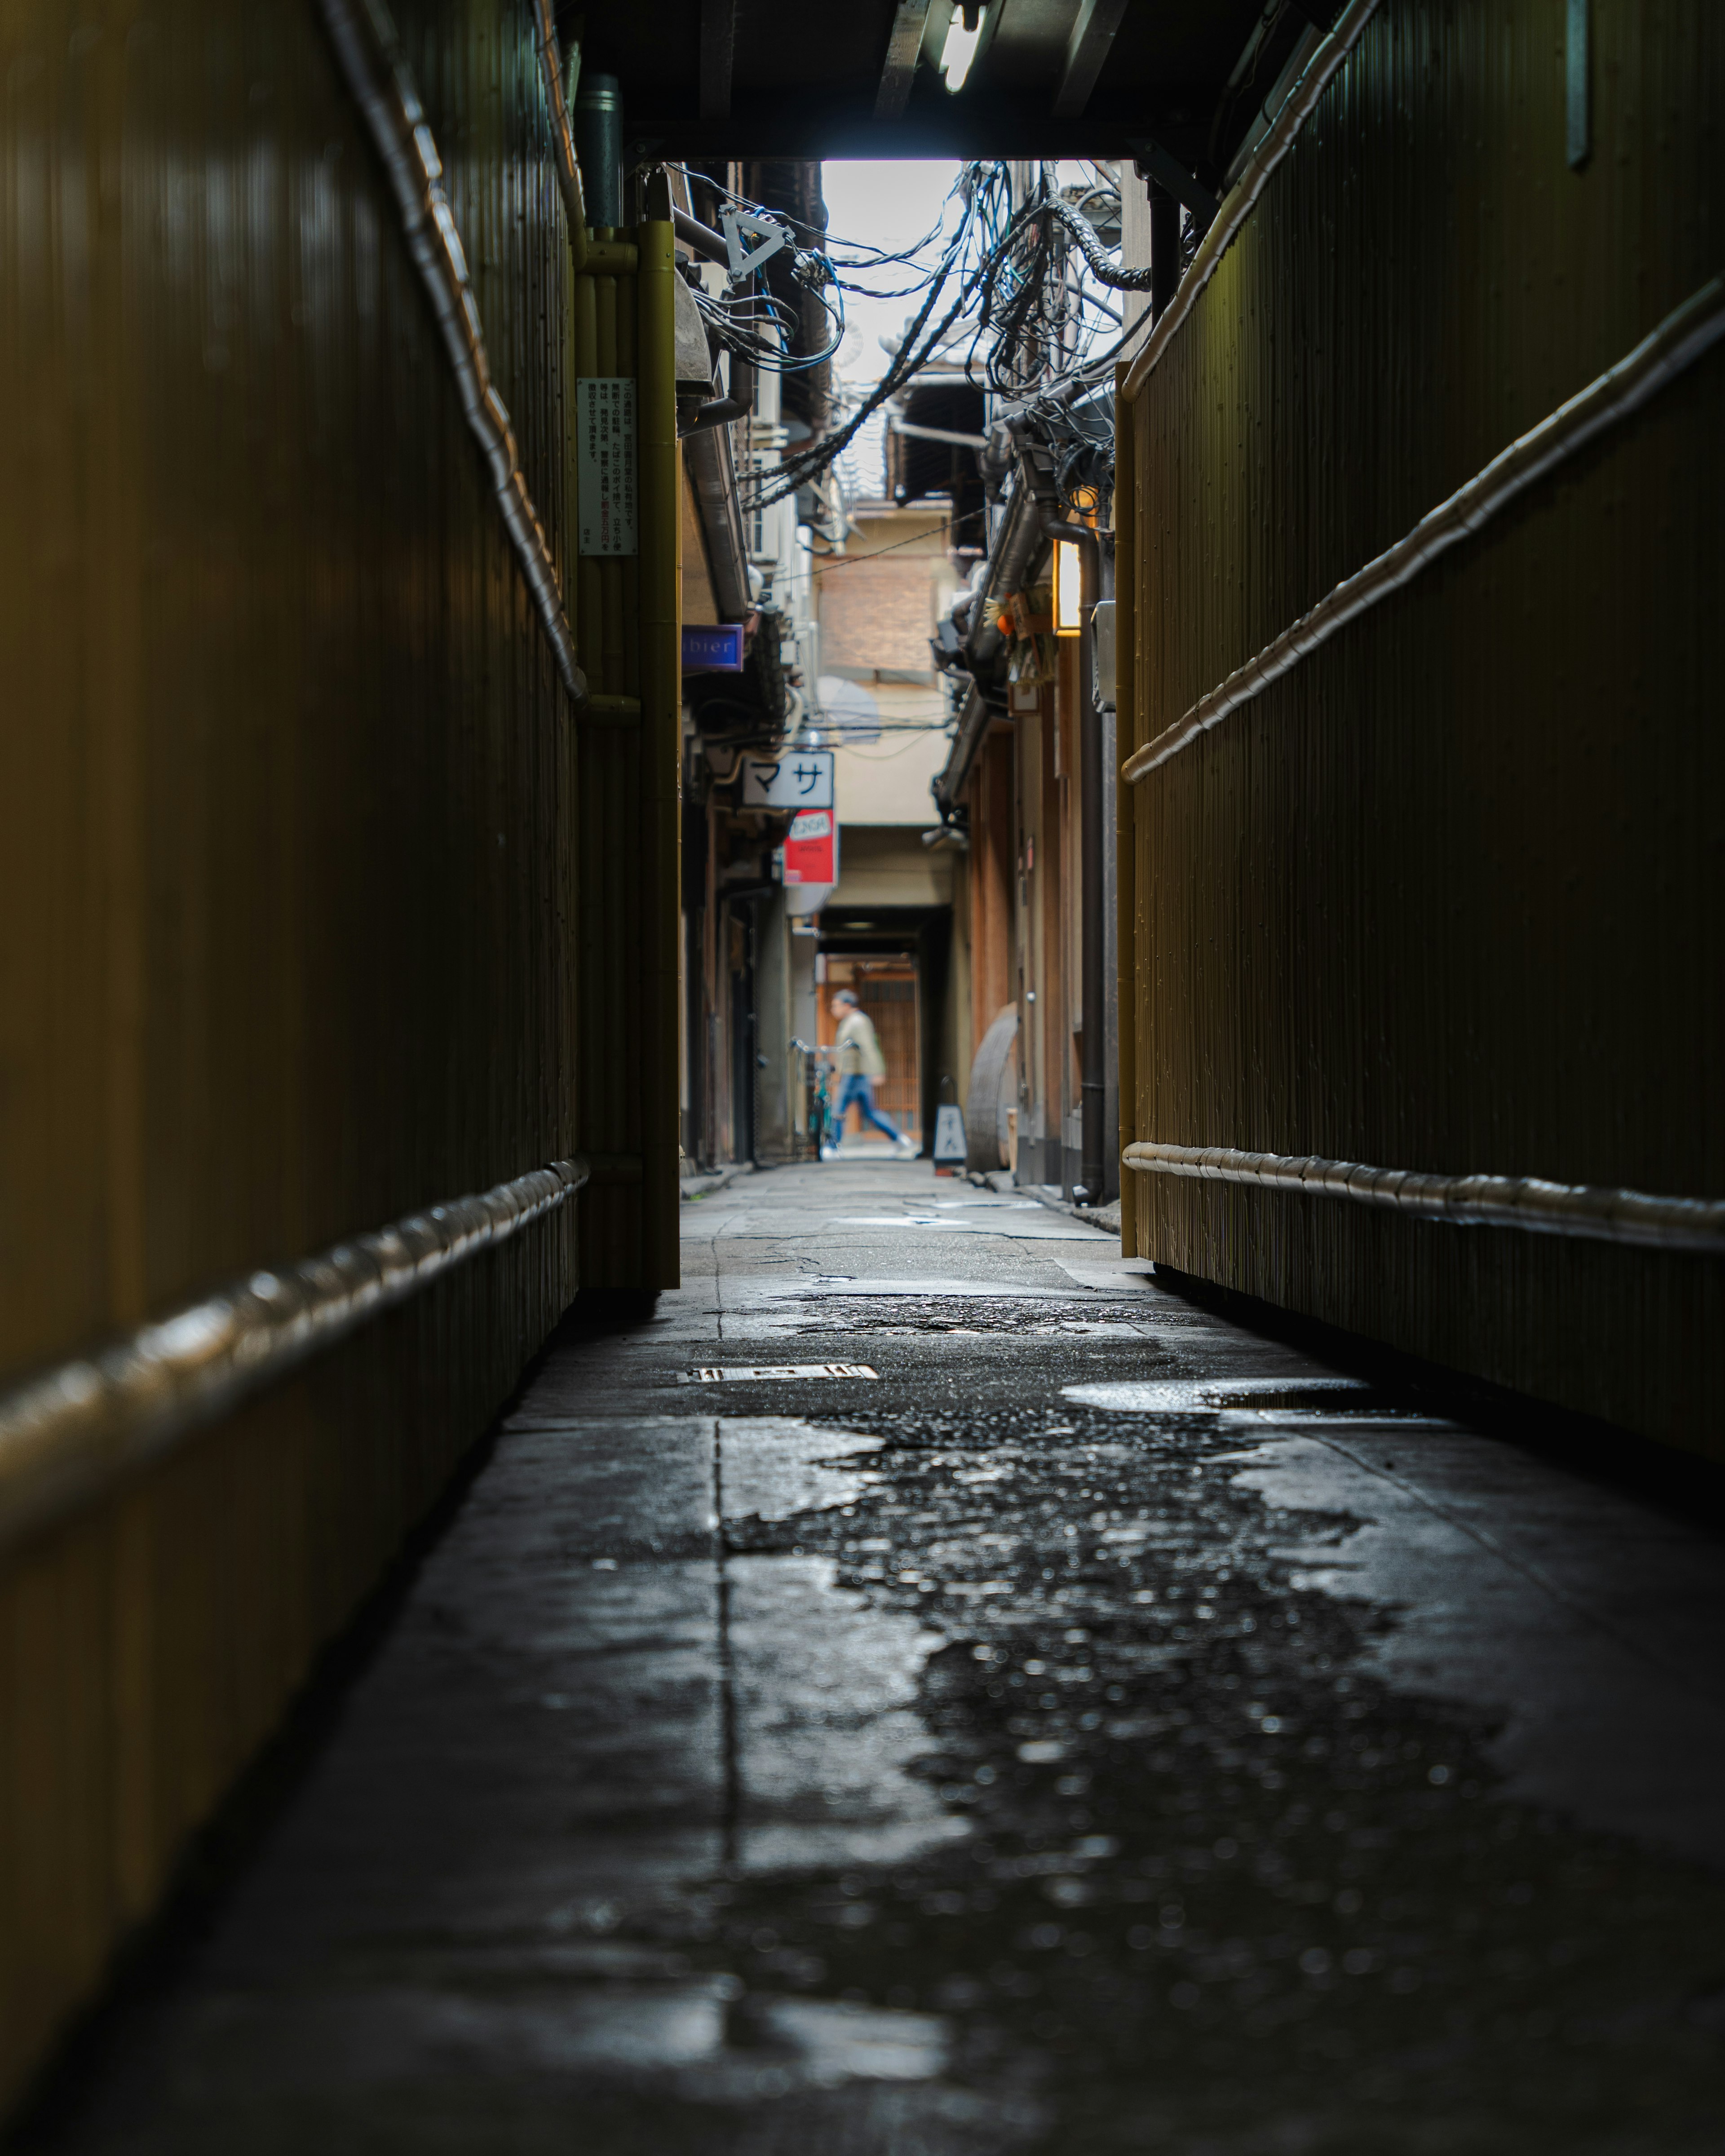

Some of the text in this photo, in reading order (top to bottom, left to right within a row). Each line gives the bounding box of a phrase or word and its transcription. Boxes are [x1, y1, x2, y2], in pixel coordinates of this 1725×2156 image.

[588, 383, 597, 463] 徴収させて頂きます。
[584, 529, 590, 544] 店主
[750, 762, 823, 795] マサ
